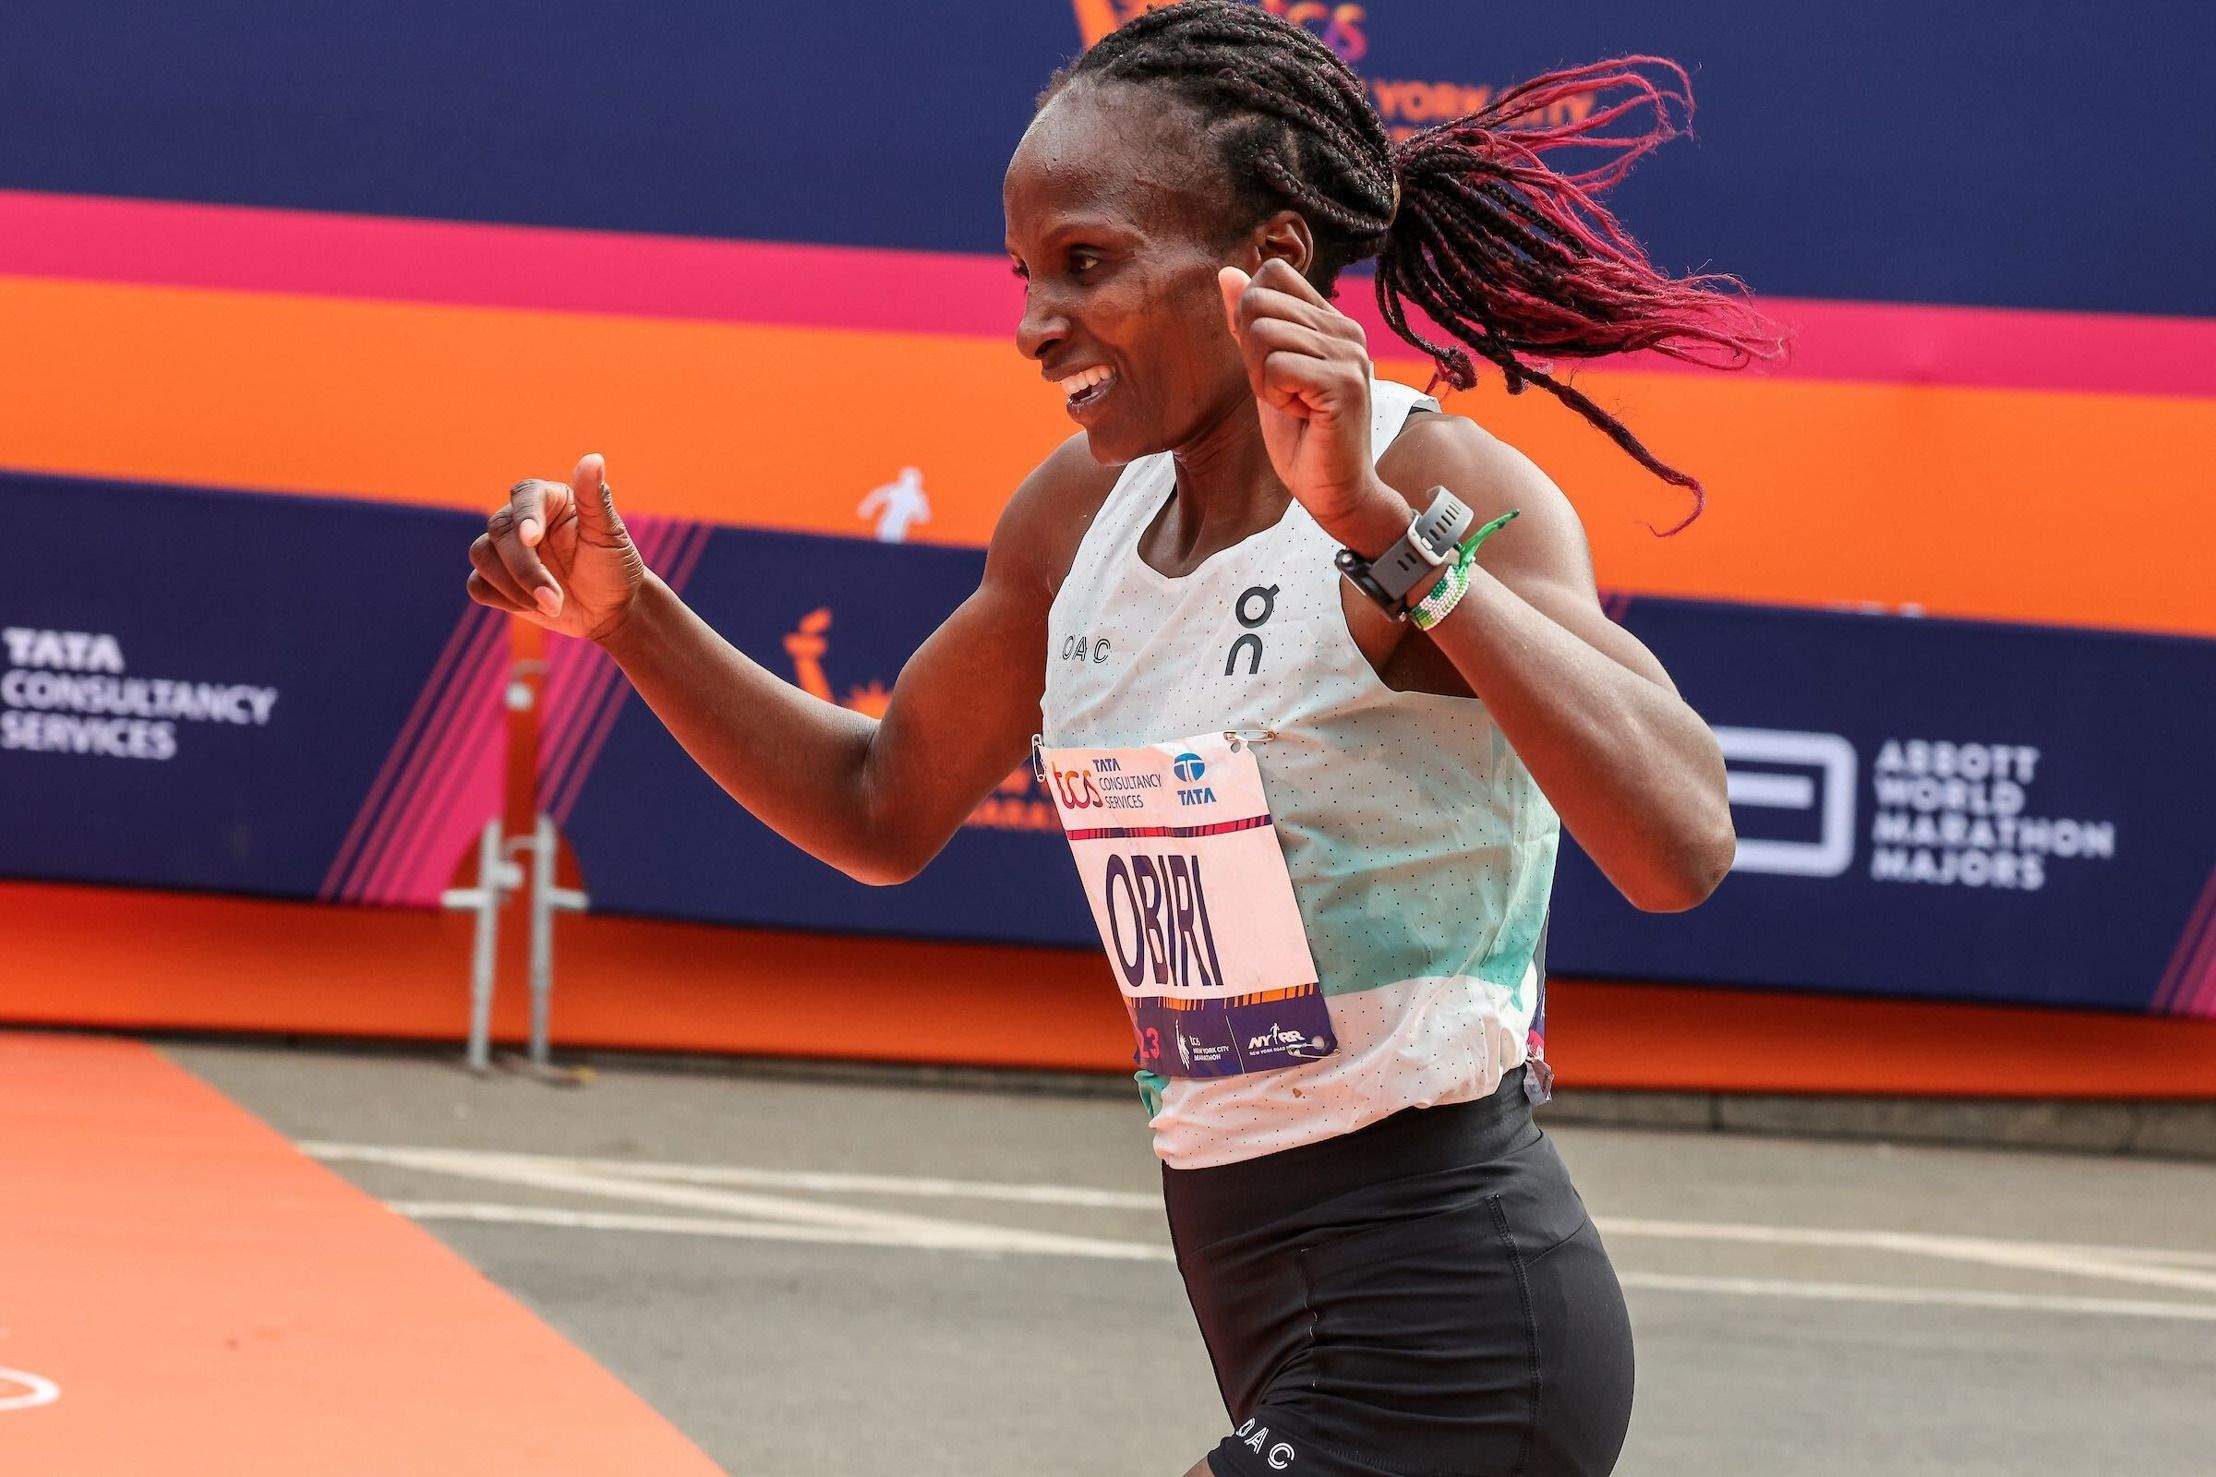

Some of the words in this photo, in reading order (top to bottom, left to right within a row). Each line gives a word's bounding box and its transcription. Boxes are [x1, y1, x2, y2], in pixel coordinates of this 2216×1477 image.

[2, 627, 126, 674] TATA
[0, 669, 278, 726] CONSULTANCY
[0, 710, 177, 760] SERVICES
[1093, 758, 1121, 772] TATA
[1099, 773, 1162, 791] CONSULTANCY
[1875, 739, 2040, 784] ABBOTT
[1105, 794, 1144, 809] SERVICES
[1177, 787, 1217, 806] TATA
[1875, 776, 2026, 816] WORLD
[1872, 811, 2116, 858] MARATHON
[1870, 846, 2045, 890] MAJORS
[1105, 853, 1224, 987] OBIRI
[1203, 1046, 1217, 1054] YORK
[1217, 1045, 1229, 1053] CITY
